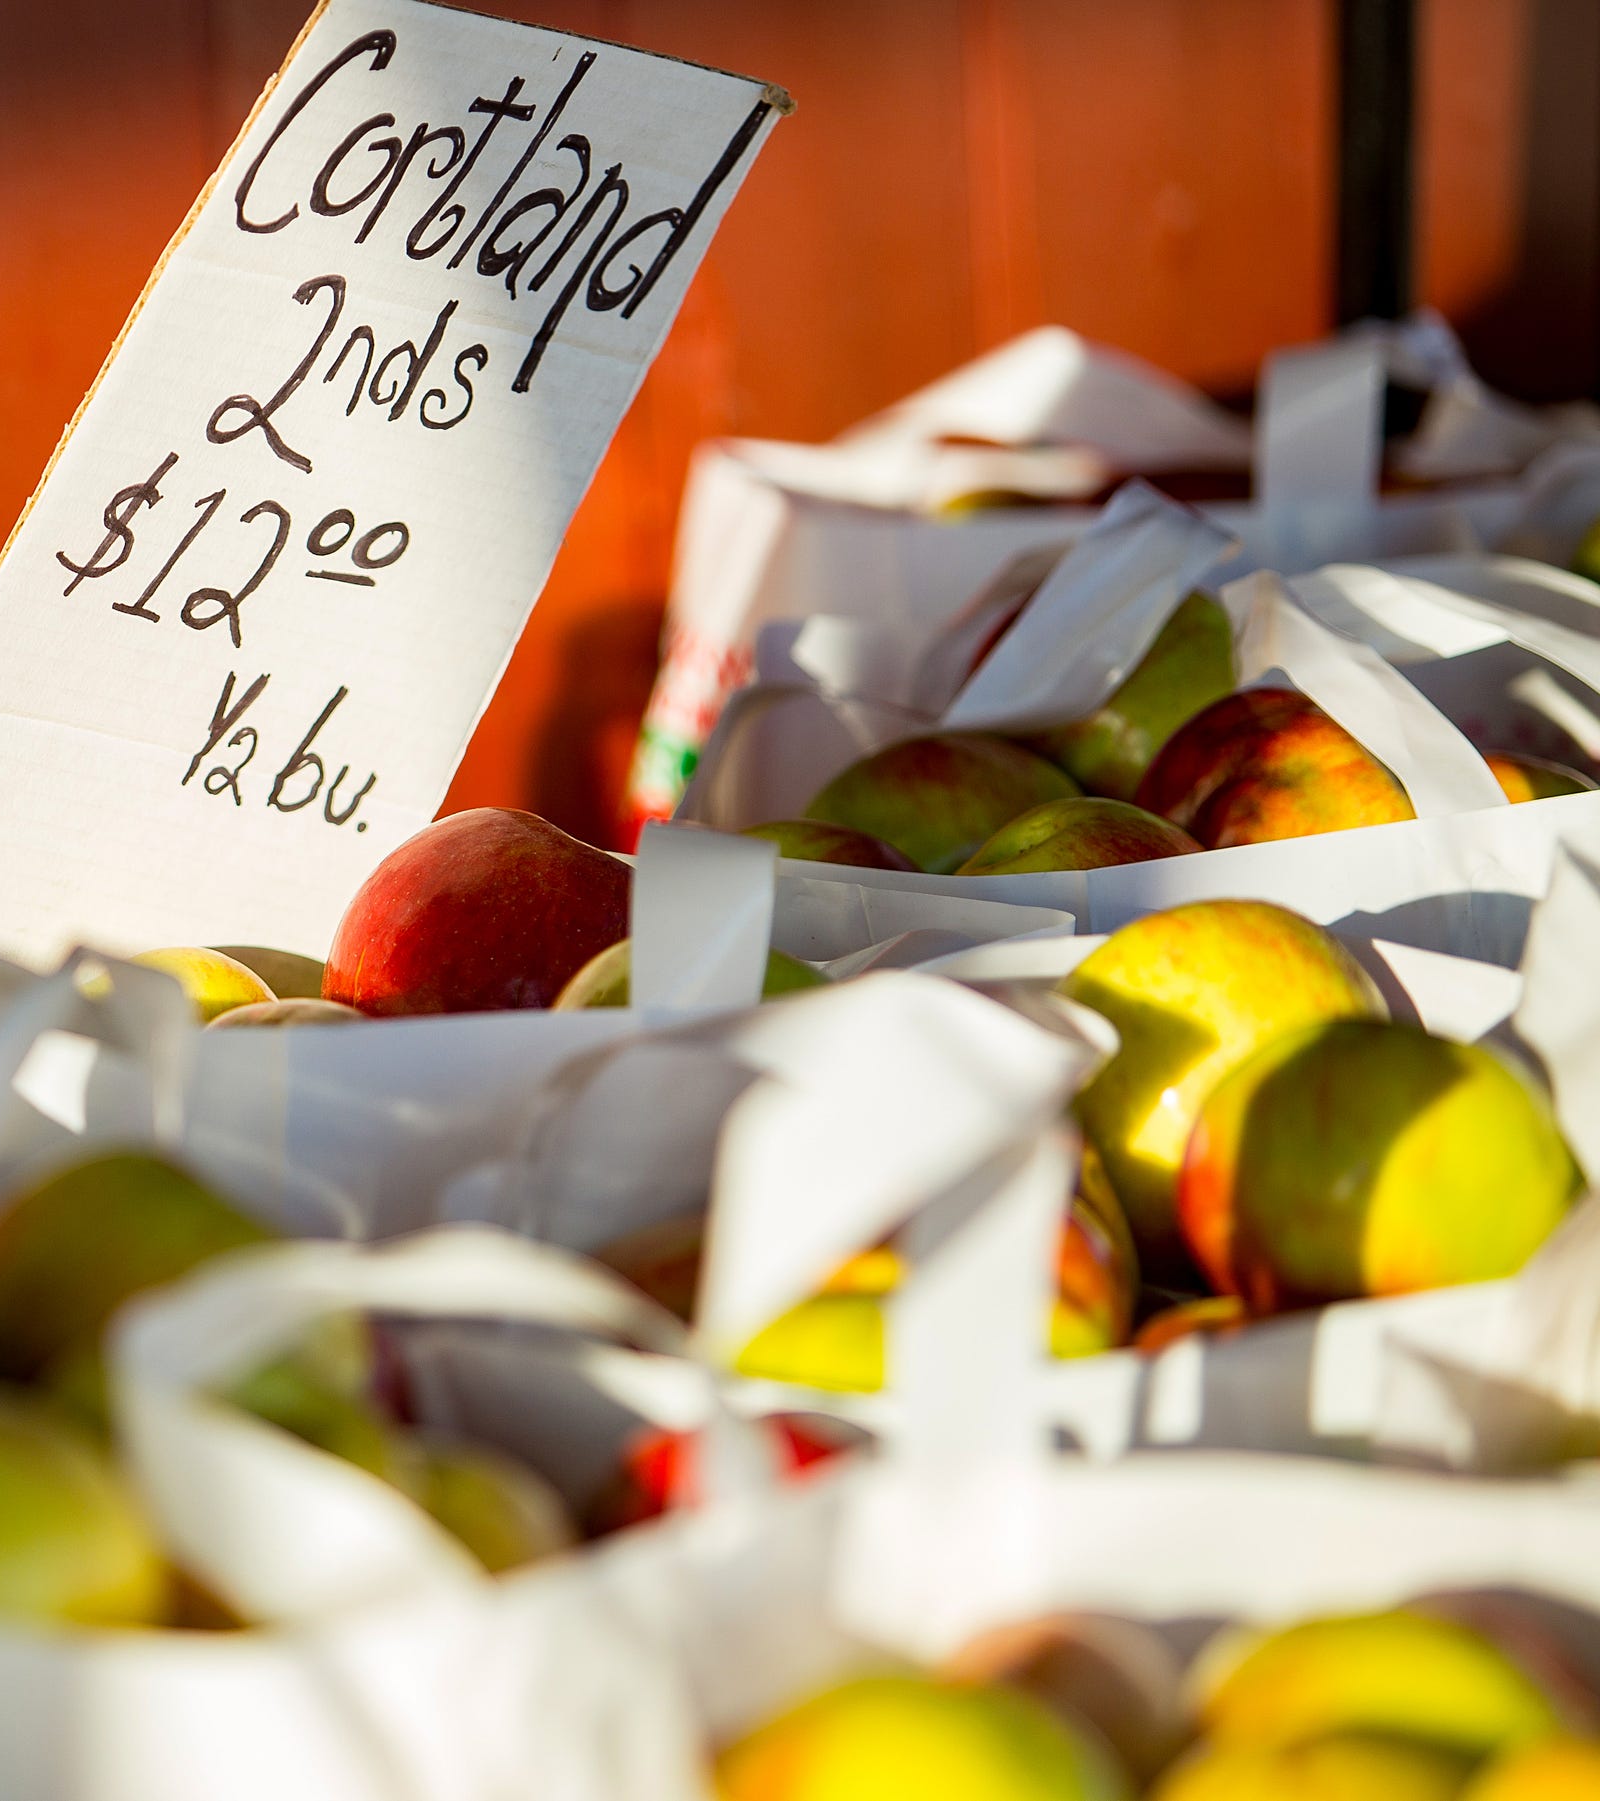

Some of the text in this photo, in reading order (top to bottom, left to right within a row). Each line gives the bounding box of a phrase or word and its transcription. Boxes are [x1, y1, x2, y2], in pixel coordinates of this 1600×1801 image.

[236, 27, 774, 394] Cortland
[206, 274, 488, 474] 2nds
[267, 685, 377, 833] bu.
